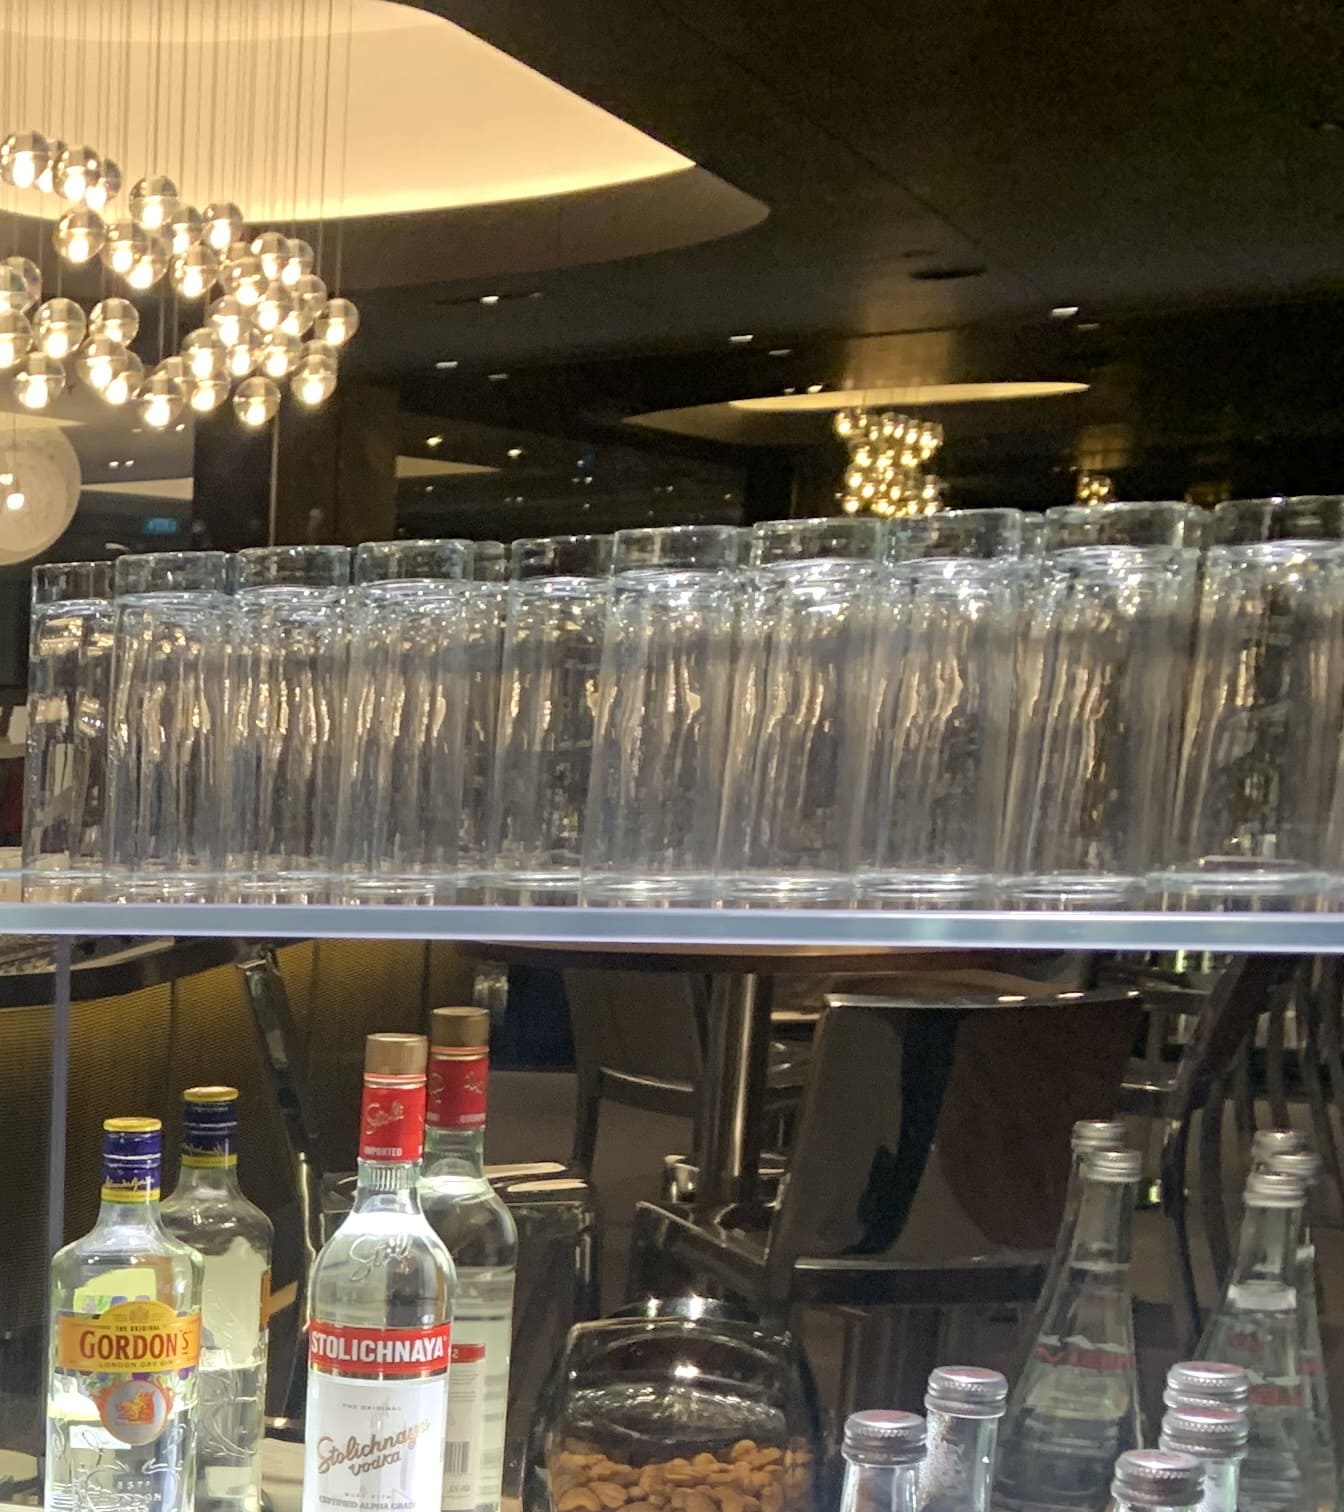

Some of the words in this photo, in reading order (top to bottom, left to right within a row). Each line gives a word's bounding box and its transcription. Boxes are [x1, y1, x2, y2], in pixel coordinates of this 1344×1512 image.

[79, 1330, 192, 1361] GORDON'S
[311, 1331, 445, 1363] STOLICHNAYA
[348, 1450, 402, 1476] vodka
